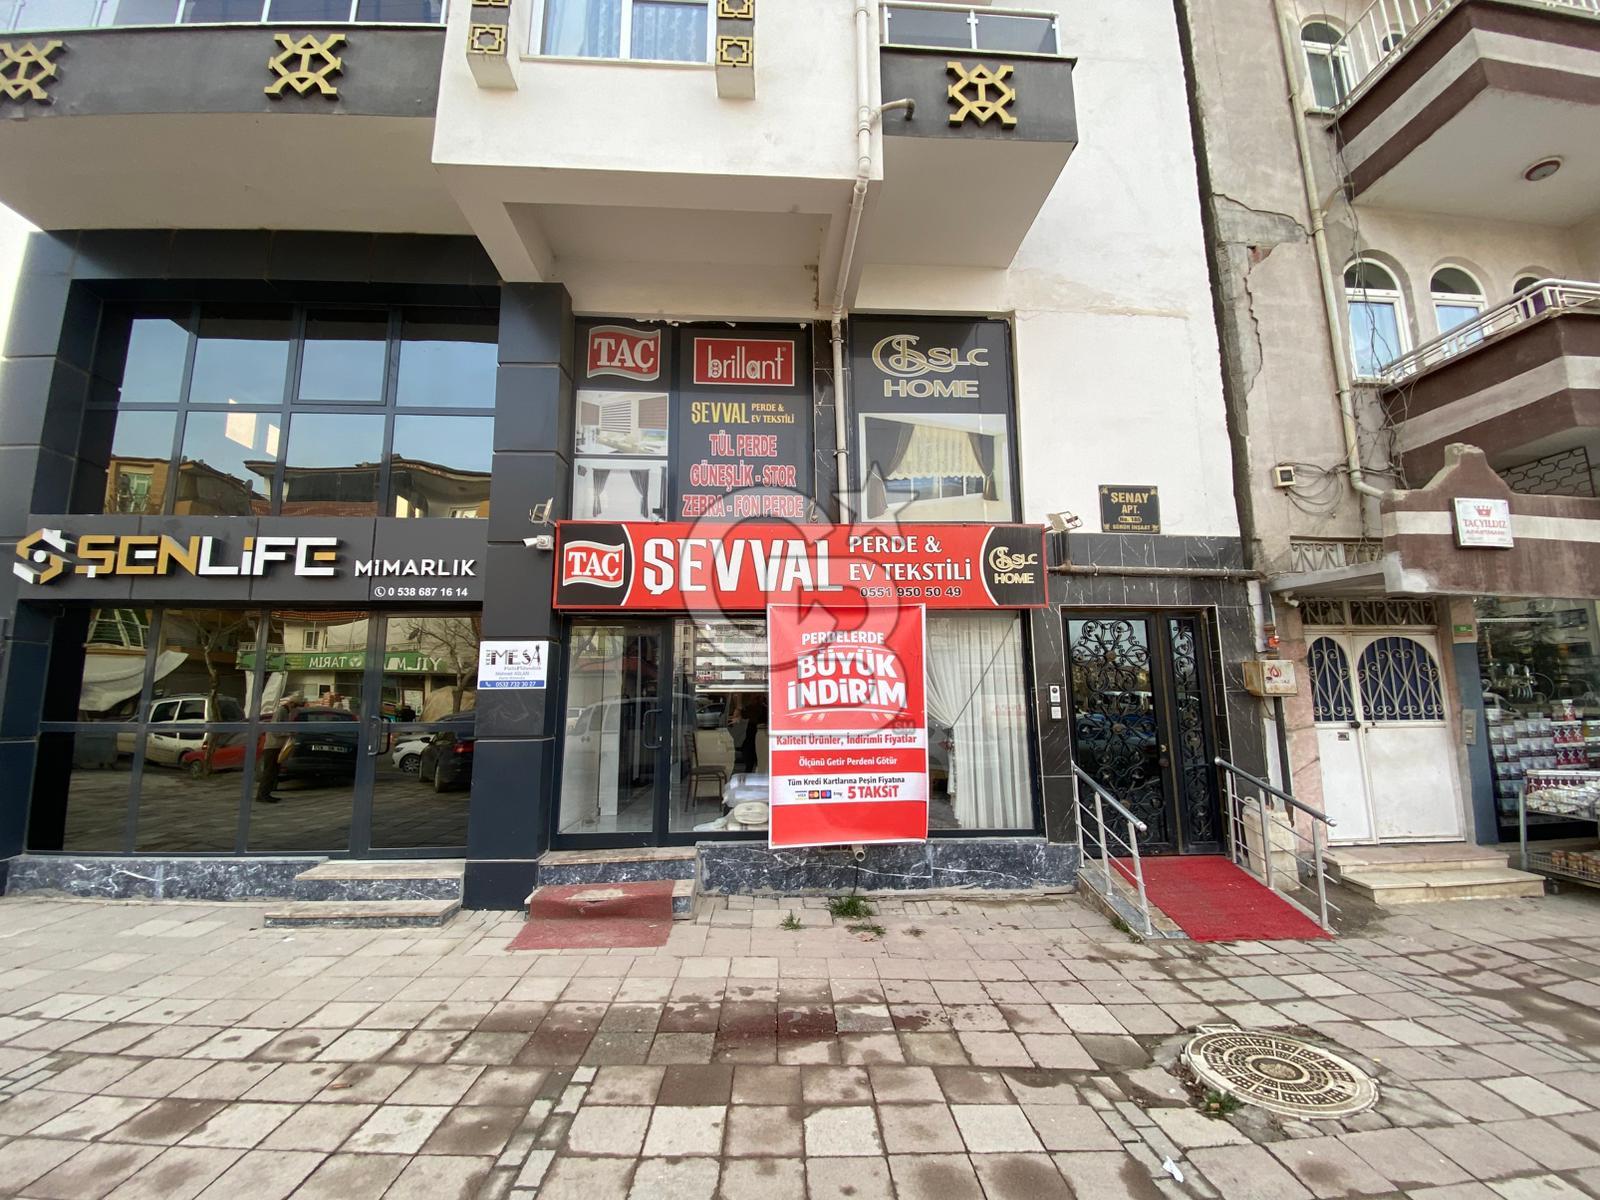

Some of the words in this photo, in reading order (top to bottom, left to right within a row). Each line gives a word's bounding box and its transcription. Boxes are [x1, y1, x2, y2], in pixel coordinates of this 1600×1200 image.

[593, 337, 655, 373] TAÇ
[707, 344, 785, 380] brillant
[883, 379, 980, 398] HOME
[691, 401, 750, 424] ŞEVVAL
[751, 403, 776, 412] PERDE
[777, 403, 785, 412] &
[751, 414, 762, 424] EV
[763, 413, 795, 424] TEKSTİLİ
[709, 429, 735, 456] TÜL
[736, 434, 778, 457] PERDE
[689, 459, 754, 492] GÜNEŞLİK
[762, 464, 797, 487] STOR
[682, 494, 726, 517] ZEBRA
[733, 494, 761, 517] FON
[762, 494, 804, 518] PERDE
[1121, 504, 1140, 514] APT.
[354, 558, 477, 577] MİMARLIK
[567, 551, 620, 581] TAÇ
[643, 538, 844, 595] ŞEVVAL
[849, 535, 918, 554] PERDE
[924, 535, 943, 554] &
[849, 563, 877, 581] EV
[881, 558, 972, 581] TEKSTİLİ
[994, 572, 1035, 584] HOME
[388, 586, 395, 597] 0
[397, 586, 416, 597] 538
[418, 586, 437, 597] 687
[440, 586, 452, 597] 16
[455, 586, 468, 597] 14
[860, 586, 892, 598] 0551
[896, 586, 921, 598] 950
[925, 586, 941, 598] 50
[945, 585, 961, 597] 49
[801, 631, 885, 645] PERDELERDE
[490, 645, 541, 666] MESA
[797, 648, 898, 679] BÜYÜK
[776, 734, 807, 746] Kaliteli
[808, 732, 844, 746] Ürünler,
[846, 732, 883, 744] İndirimli
[884, 732, 917, 746] Fiyatlar
[799, 756, 825, 768] Ölçünü
[826, 757, 845, 767] Getir
[847, 756, 875, 766] Perdeni
[876, 755, 898, 765] Götür
[788, 778, 802, 787] Tüm
[803, 777, 822, 786] Kredi
[823, 776, 857, 786] Kartlarına
[858, 776, 877, 787] Peşin
[878, 775, 905, 787] Fiyatına
[847, 785, 857, 799] 5
